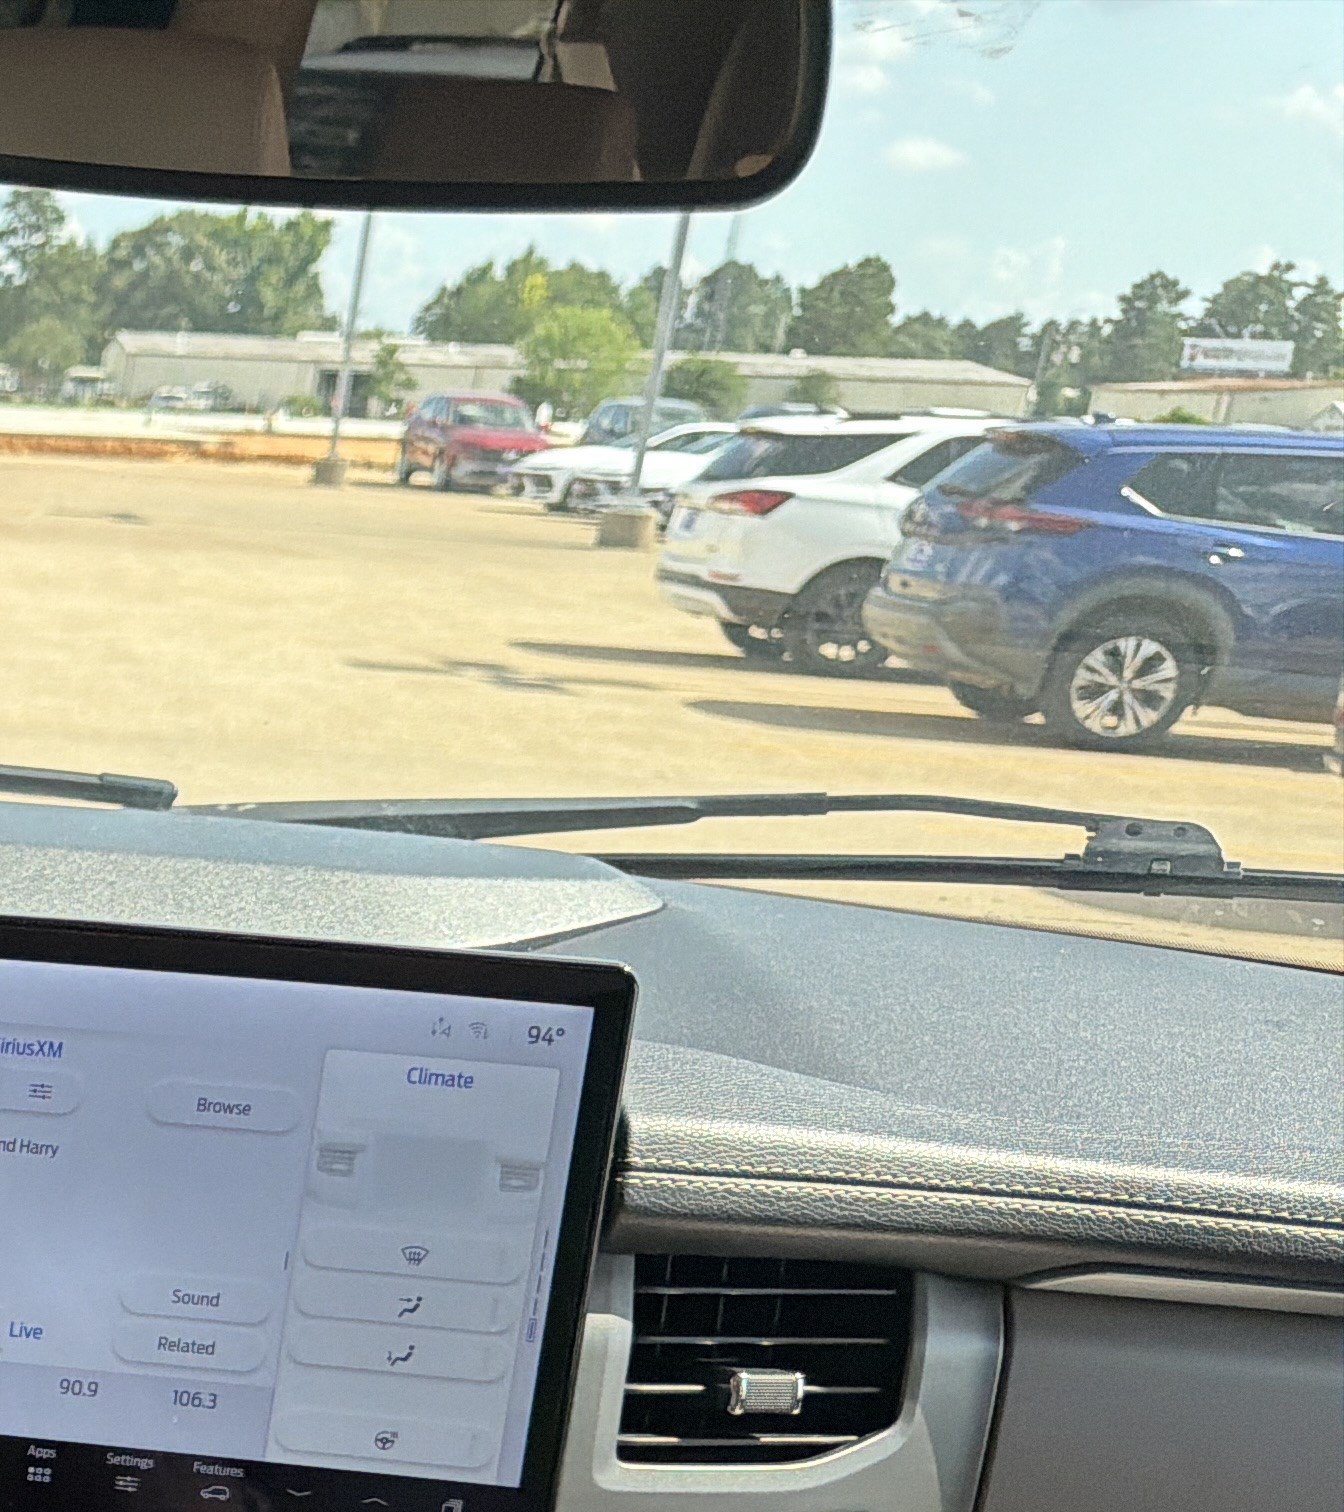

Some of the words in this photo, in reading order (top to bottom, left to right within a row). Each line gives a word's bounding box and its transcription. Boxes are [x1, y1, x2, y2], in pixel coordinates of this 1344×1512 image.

[526, 1024, 567, 1047] 94°
[406, 1066, 474, 1090] Climate
[196, 1097, 252, 1118] Browse
[19, 1138, 60, 1159] Harry
[171, 1288, 221, 1308] Sound
[9, 1321, 44, 1340] Live
[157, 1335, 216, 1356] Related
[59, 1378, 99, 1398] 90.9
[172, 1389, 218, 1411] 106.3
[26, 1444, 57, 1460] Apps
[106, 1452, 154, 1470] Settings
[192, 1461, 244, 1478] Features
